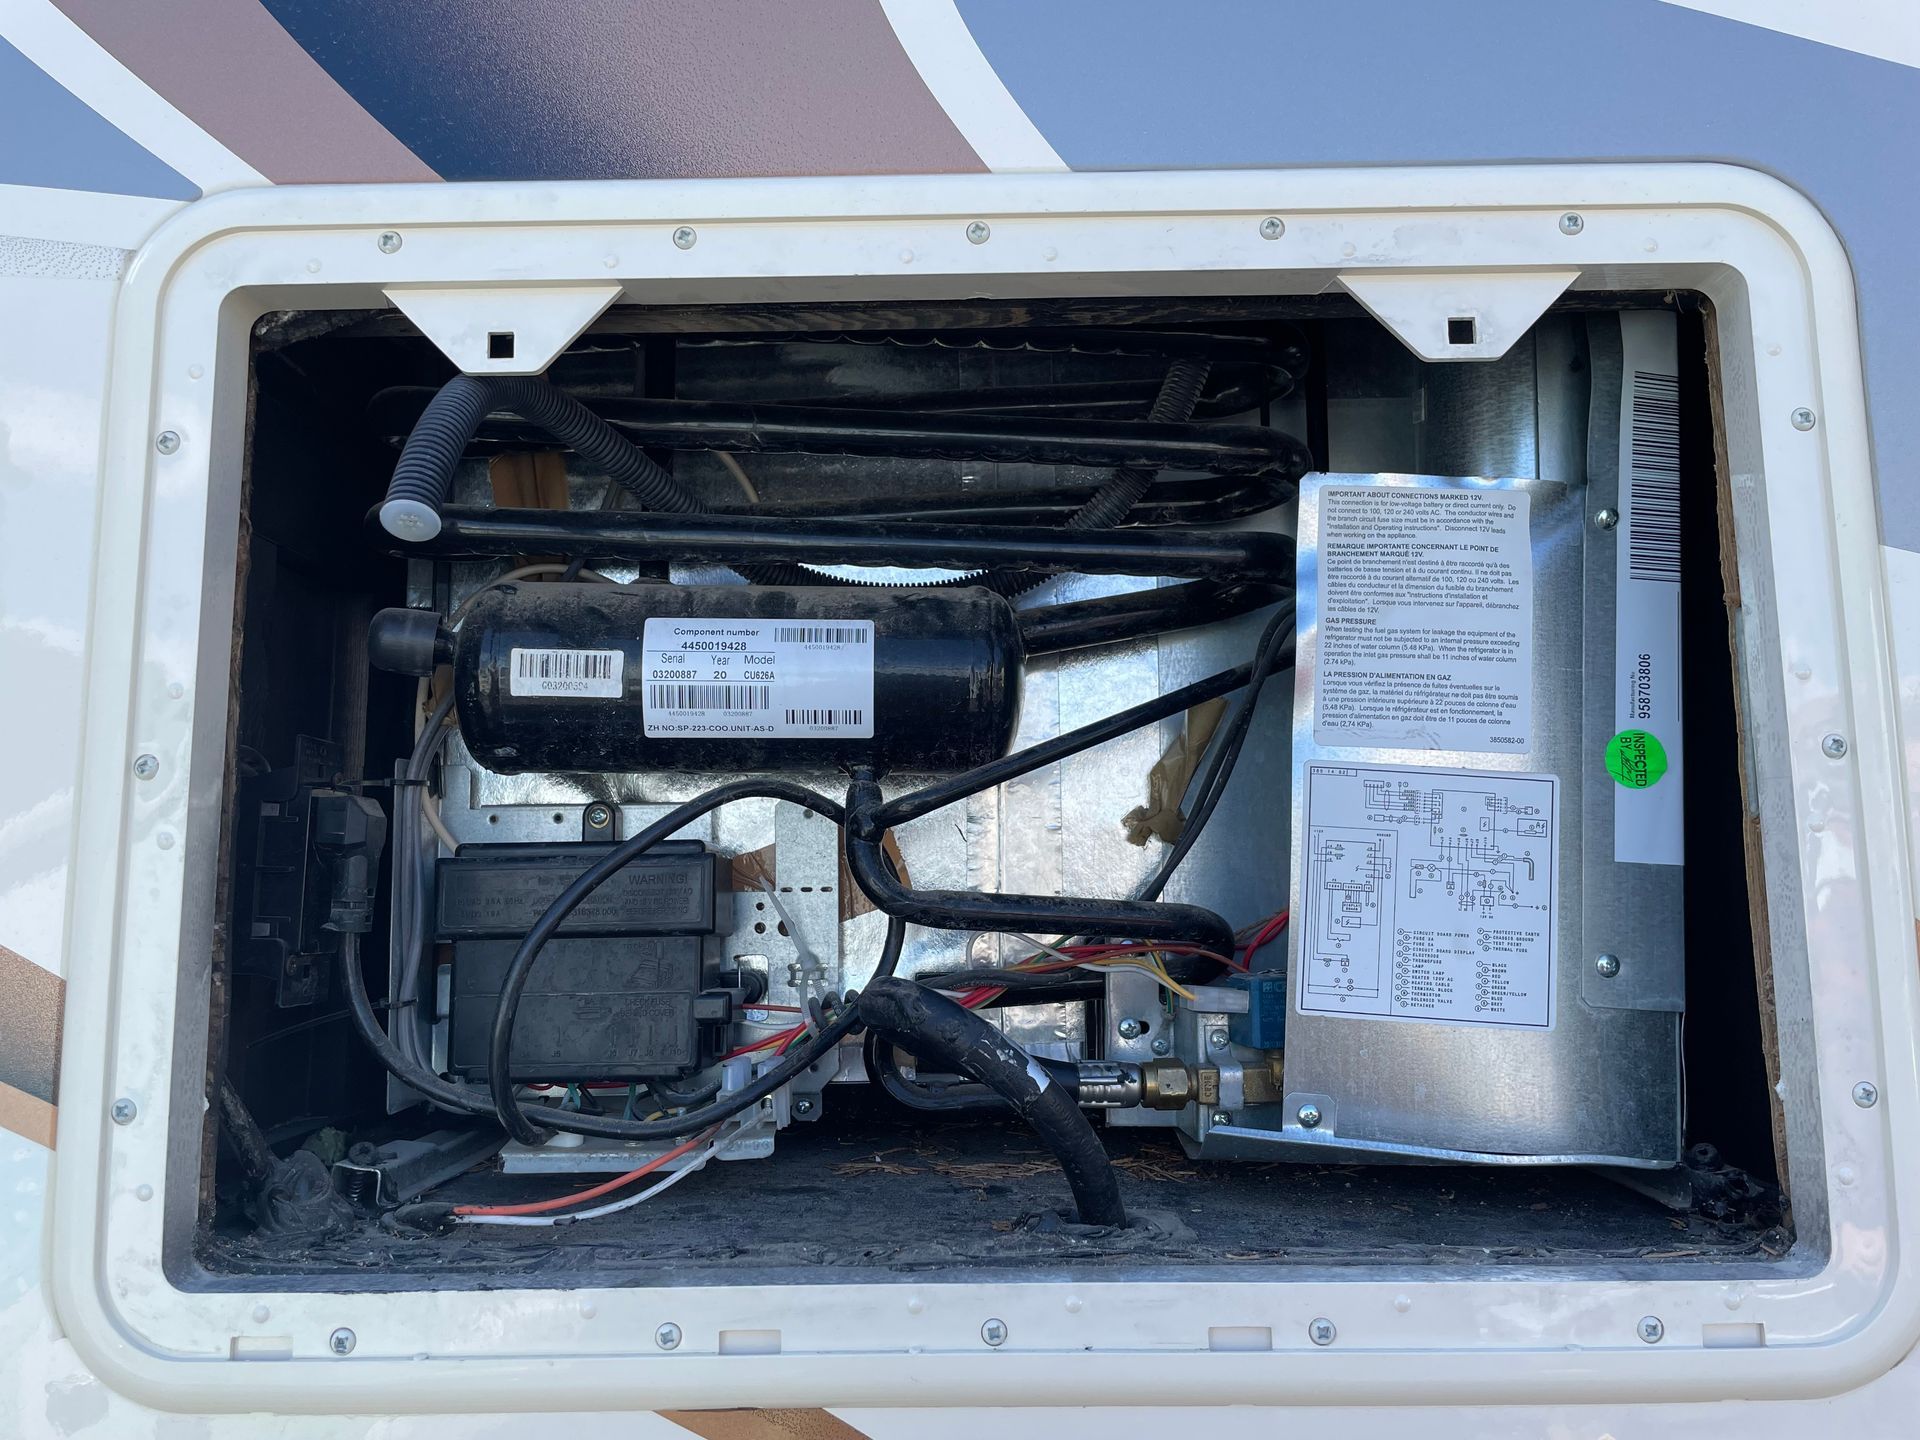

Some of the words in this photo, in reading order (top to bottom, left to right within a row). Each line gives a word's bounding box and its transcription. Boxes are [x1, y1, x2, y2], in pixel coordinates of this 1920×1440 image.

[1390, 500, 1422, 508] low-voltage
[1424, 500, 1444, 509] battery
[1488, 510, 1502, 518] wires
[1374, 524, 1403, 532] Operating
[1491, 526, 1506, 534] leads
[1344, 531, 1366, 539] working
[674, 628, 724, 637] Component
[1344, 626, 1363, 634] testing
[1432, 628, 1455, 637] leakage
[1468, 629, 1498, 638] equipment
[1325, 633, 1356, 642] refrigerator
[1394, 635, 1423, 644] subjected
[1490, 638, 1520, 648] exceeding
[681, 642, 747, 650] 4450019428
[1468, 646, 1500, 655] refrigerator
[661, 653, 685, 664] Serial
[1324, 650, 1351, 659] operation
[711, 654, 730, 665] Year
[744, 655, 775, 664] Model
[652, 670, 697, 679] 03200887
[714, 671, 727, 679] 20
[744, 671, 775, 679] CU626A
[1369, 671, 1425, 679] D'ALIMENTATION
[1639, 653, 1651, 719] 958703806
[1620, 737, 1631, 750] BY
[1634, 733, 1647, 787] INSPECTED
[629, 873, 688, 885] WARNING!
